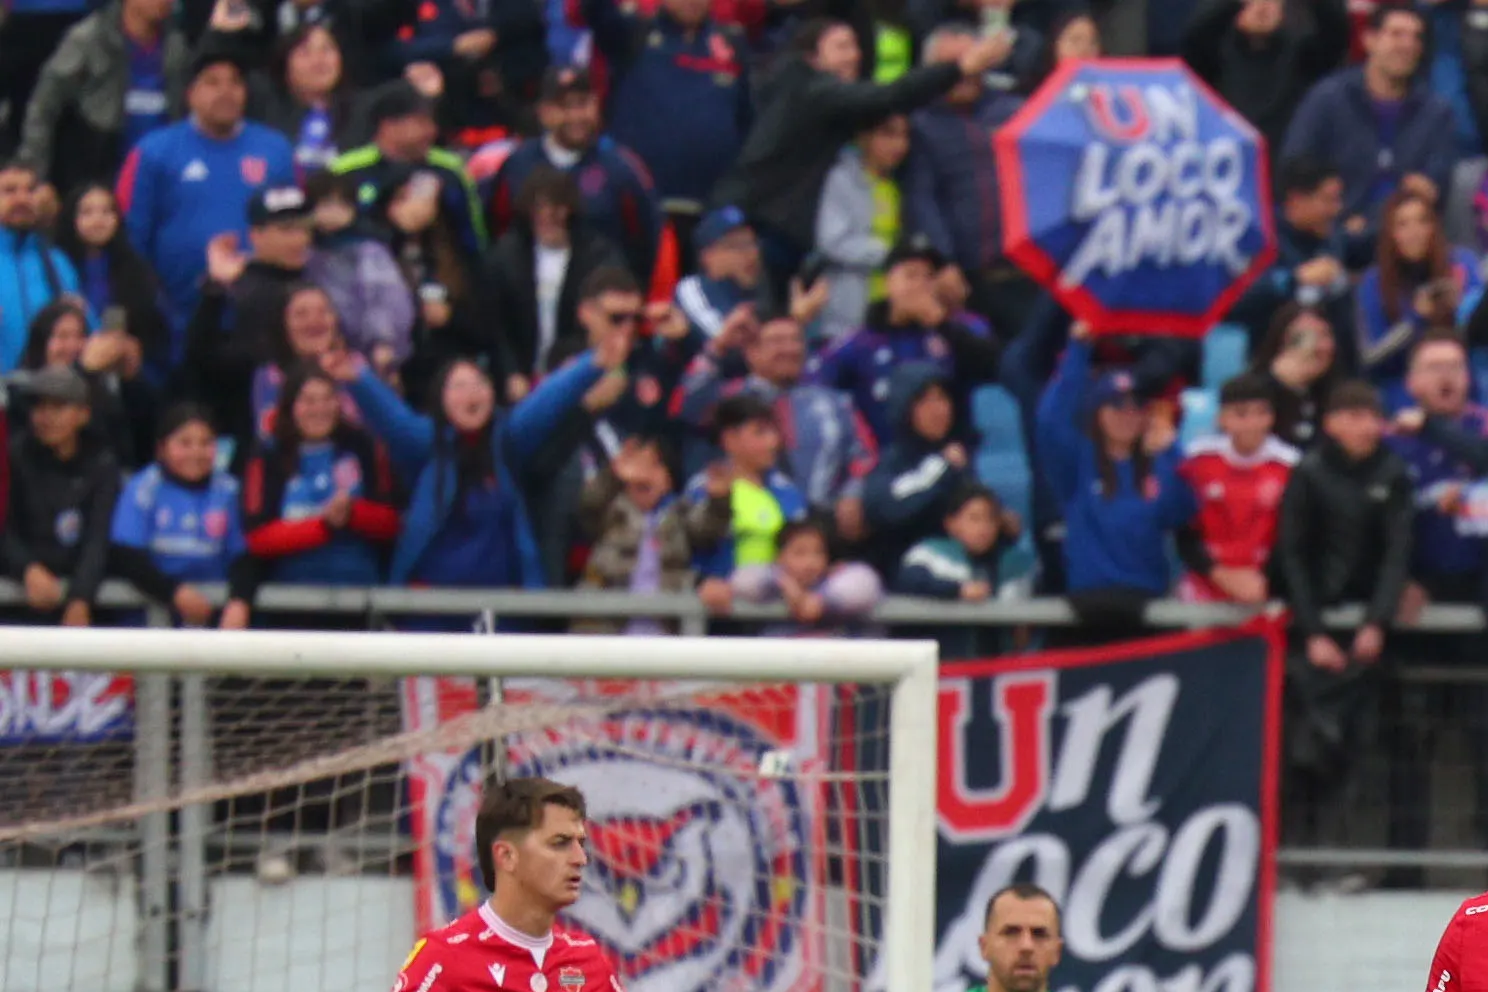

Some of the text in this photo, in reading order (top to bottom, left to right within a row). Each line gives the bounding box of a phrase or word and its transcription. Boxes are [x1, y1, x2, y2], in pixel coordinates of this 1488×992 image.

[1083, 83, 1198, 144] UN
[1071, 138, 1243, 220] LOCO
[1058, 199, 1249, 289] AMOR
